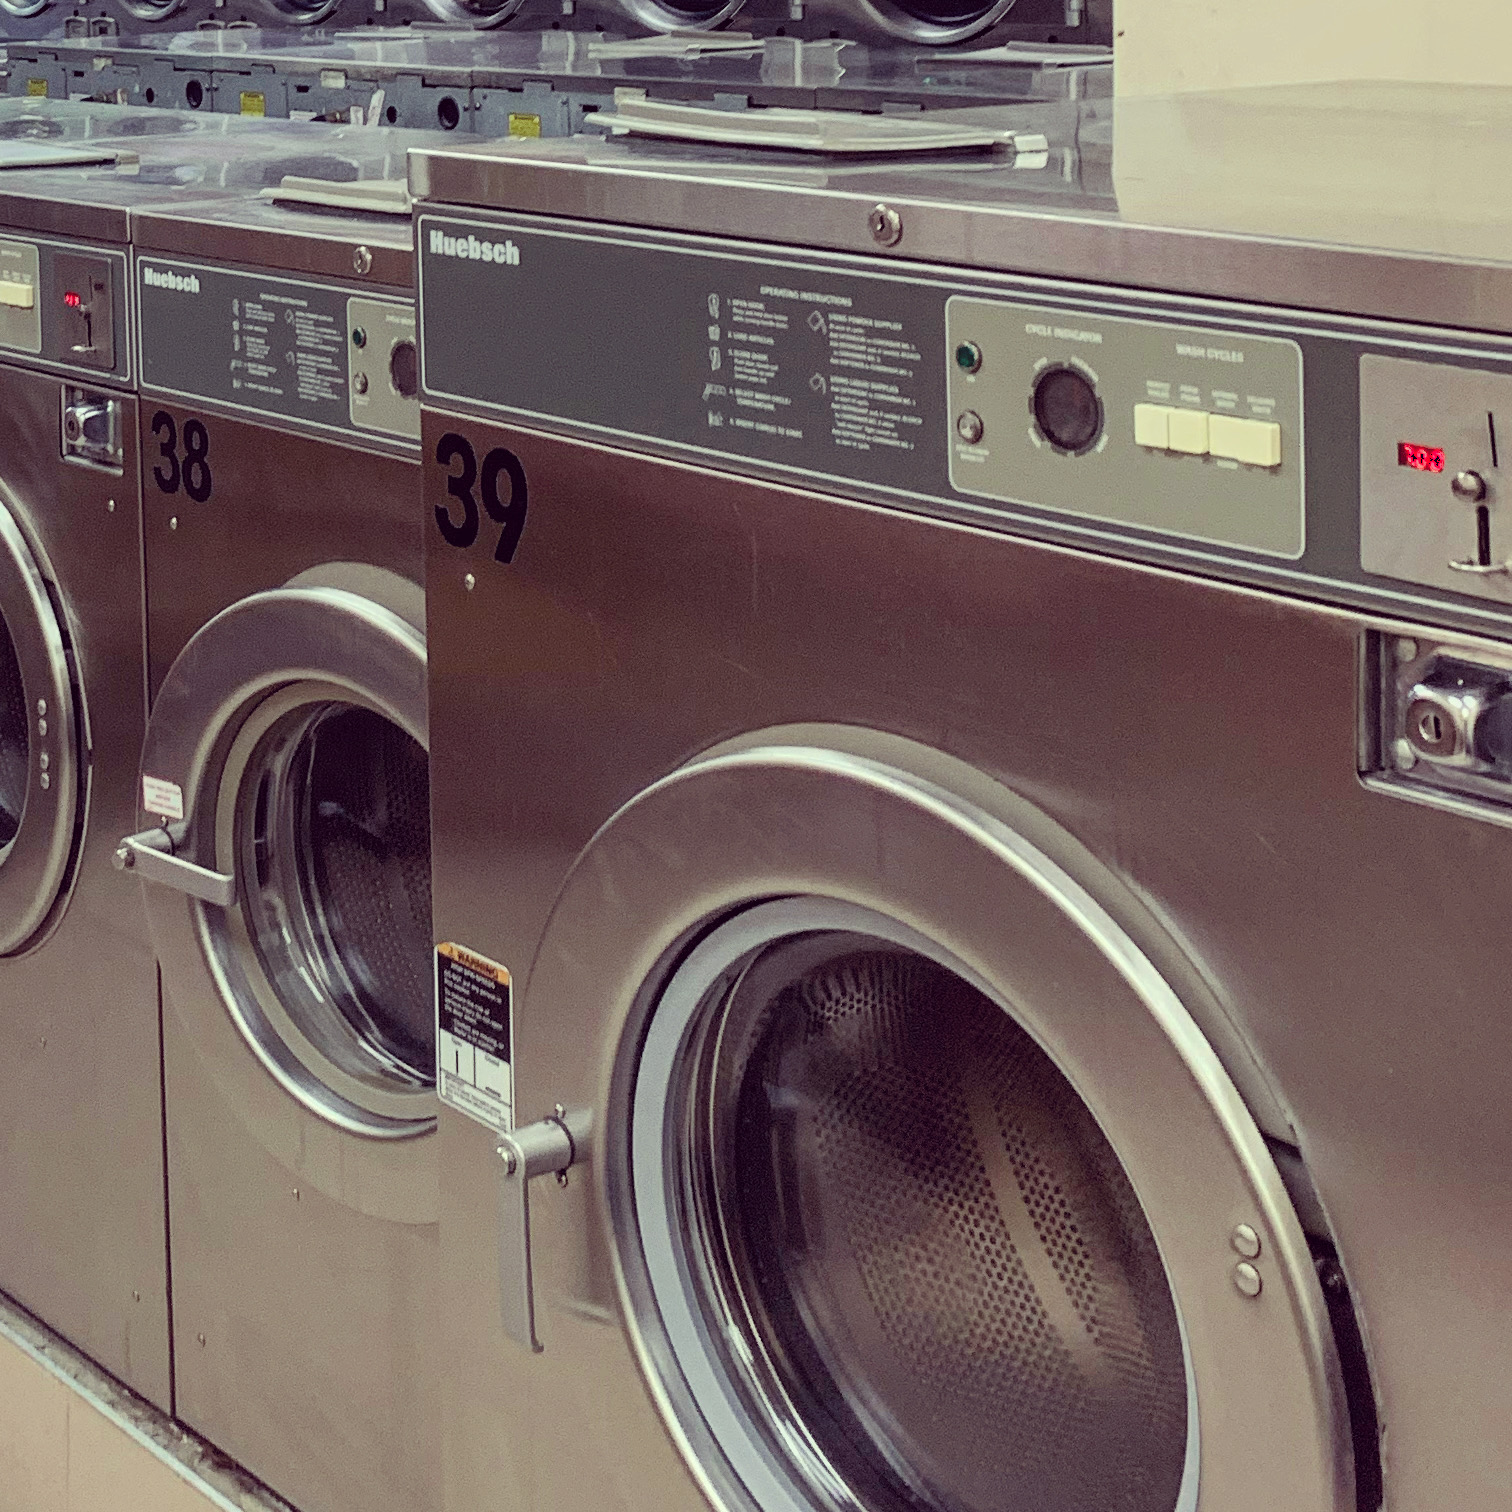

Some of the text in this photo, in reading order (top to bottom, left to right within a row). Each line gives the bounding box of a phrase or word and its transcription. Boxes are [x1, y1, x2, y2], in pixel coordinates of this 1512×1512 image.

[143, 266, 200, 294] Huebsch
[430, 229, 520, 266] Huebsch
[151, 409, 212, 503] 38
[434, 431, 529, 565] 39
